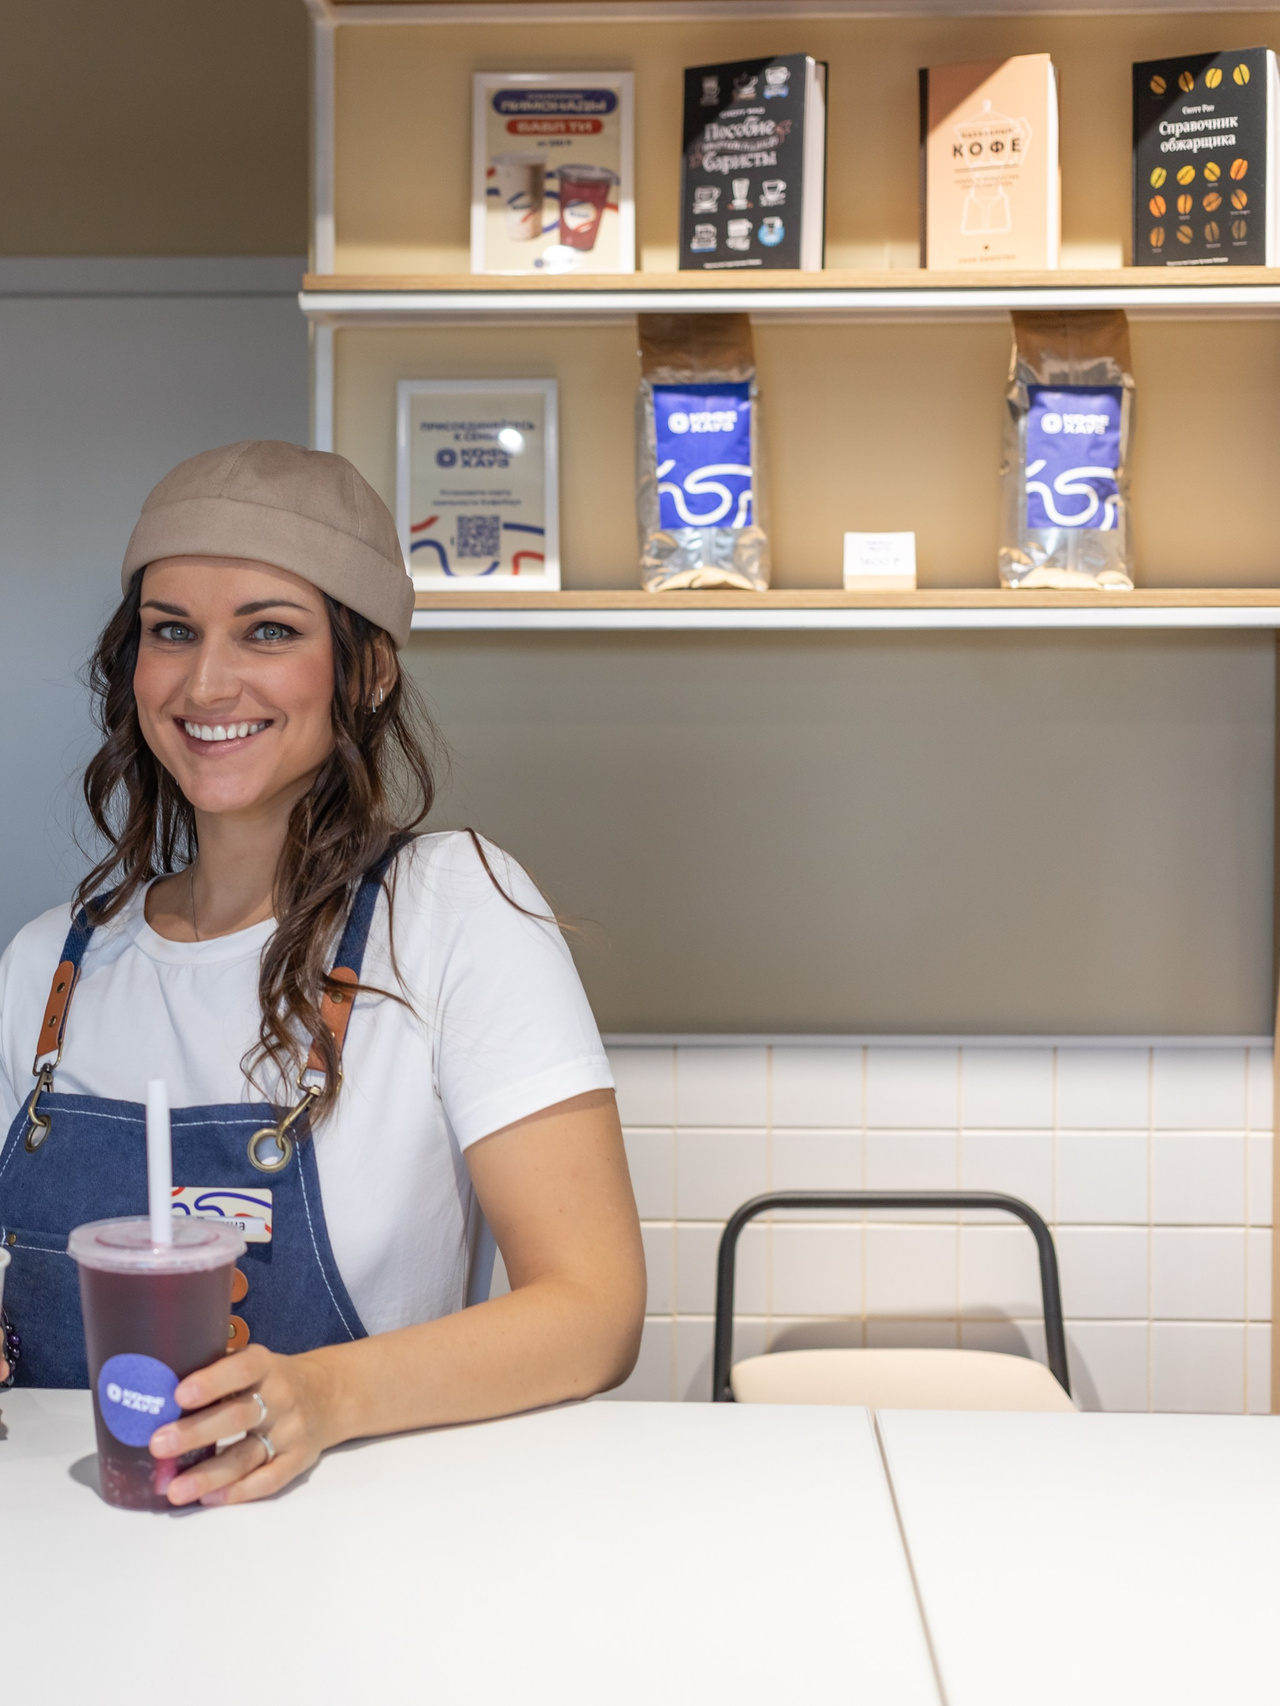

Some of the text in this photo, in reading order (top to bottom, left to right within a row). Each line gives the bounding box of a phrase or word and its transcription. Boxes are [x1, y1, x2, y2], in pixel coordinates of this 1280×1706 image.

[704, 115, 777, 142] Пособие
[1159, 116, 1239, 137] Справочник
[952, 137, 1022, 158] КОФЕ
[1160, 134, 1236, 153] обжарщика
[702, 150, 778, 175] баристы
[461, 457, 510, 468] ХАУЗ
